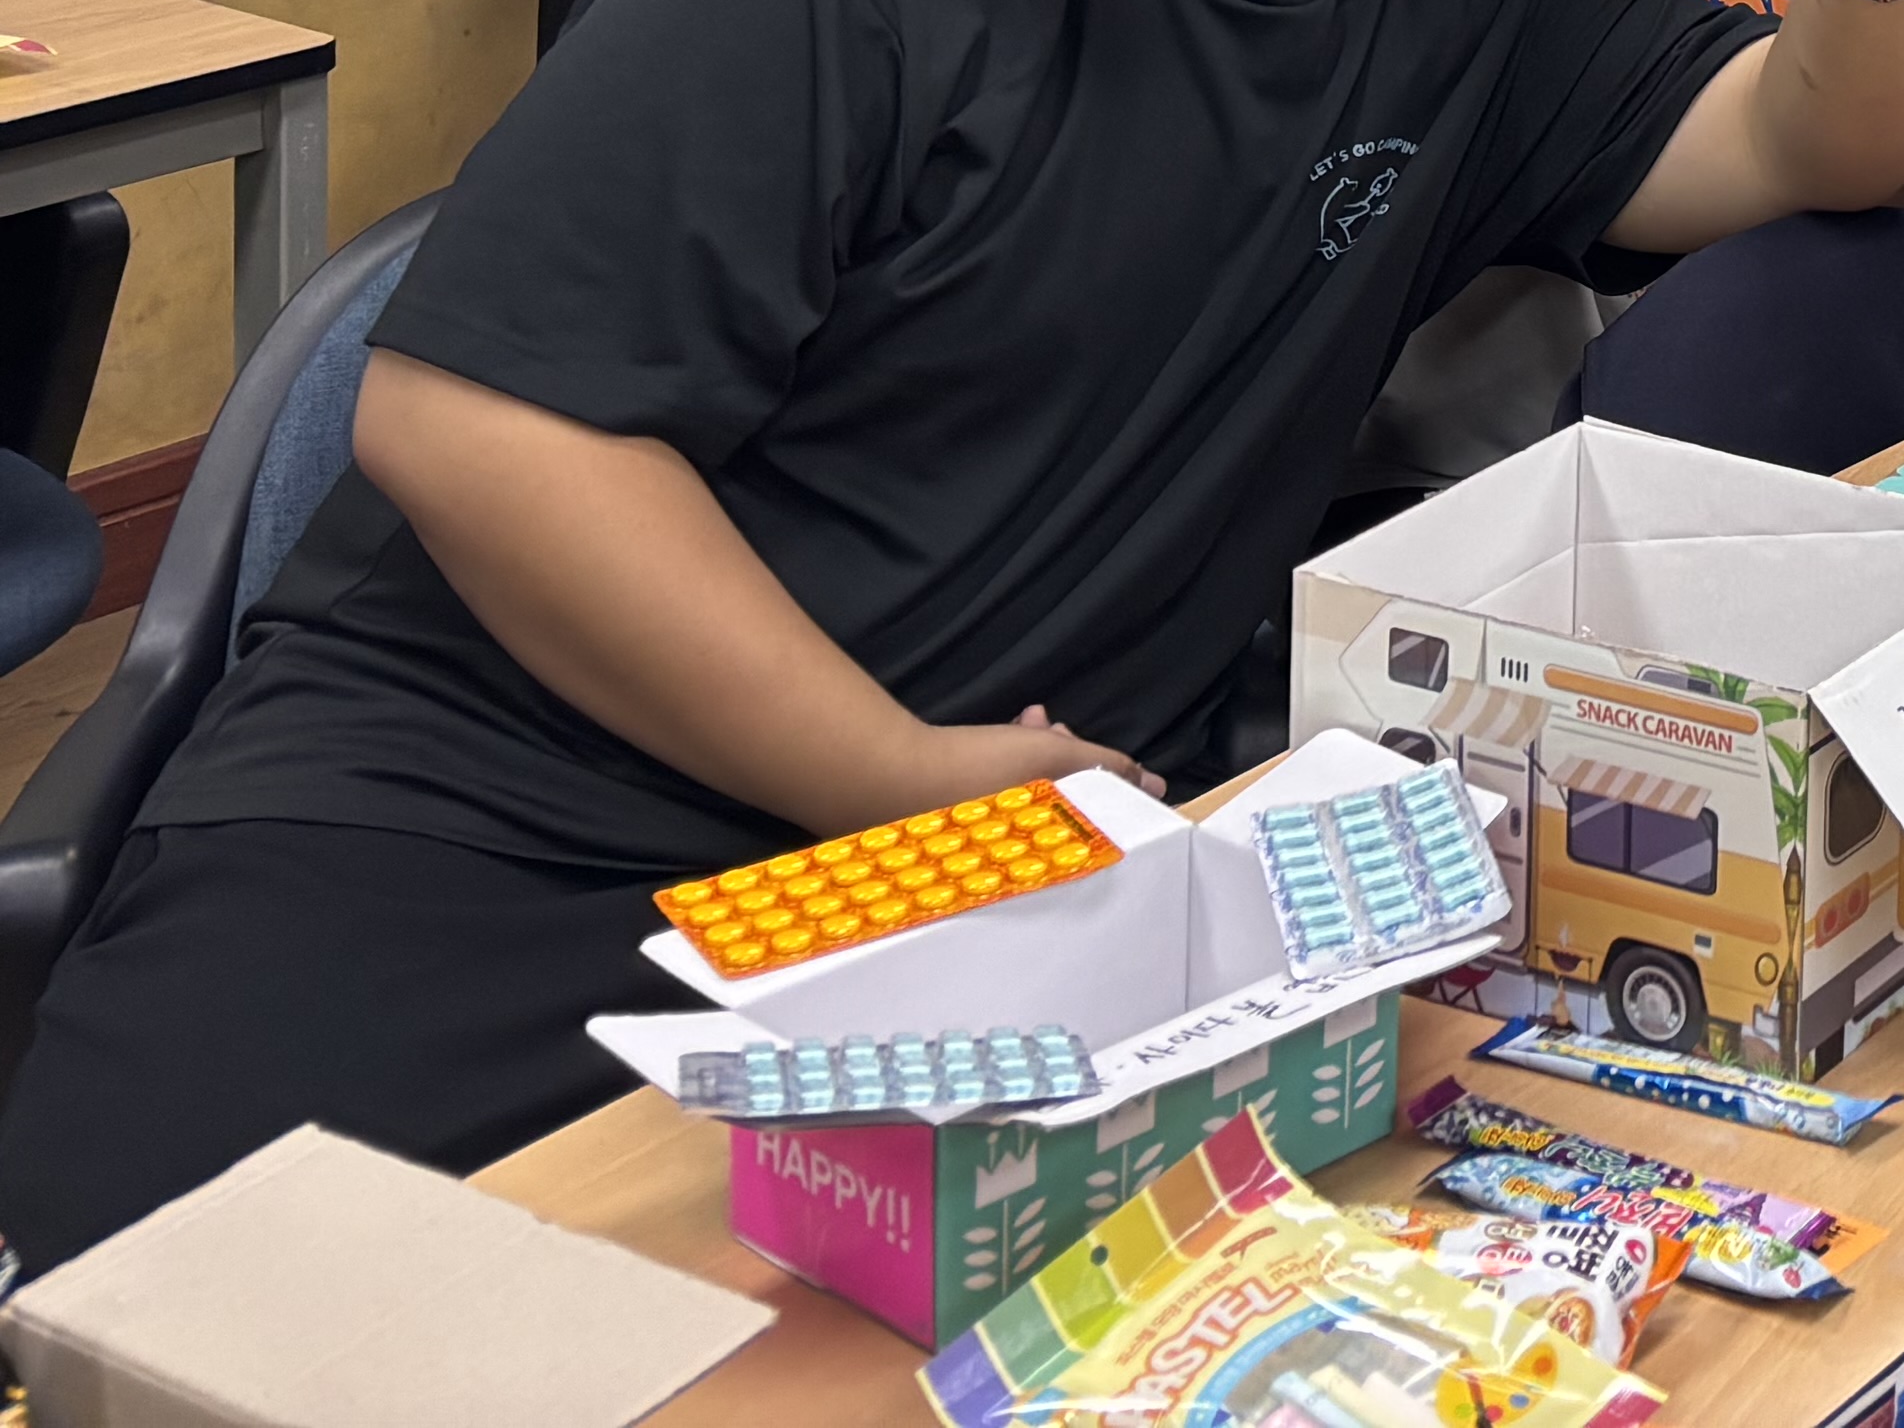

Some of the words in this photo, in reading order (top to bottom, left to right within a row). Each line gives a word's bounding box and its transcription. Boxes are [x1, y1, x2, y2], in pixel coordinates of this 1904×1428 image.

[1310, 149, 1349, 182] LET'S
[1352, 141, 1375, 157] GO
[1576, 699, 1639, 732] SNACK
[1642, 716, 1733, 753] CARAVAN
[756, 1131, 911, 1254] HAPPY!!
[1098, 1275, 1302, 1428] ASTEL
